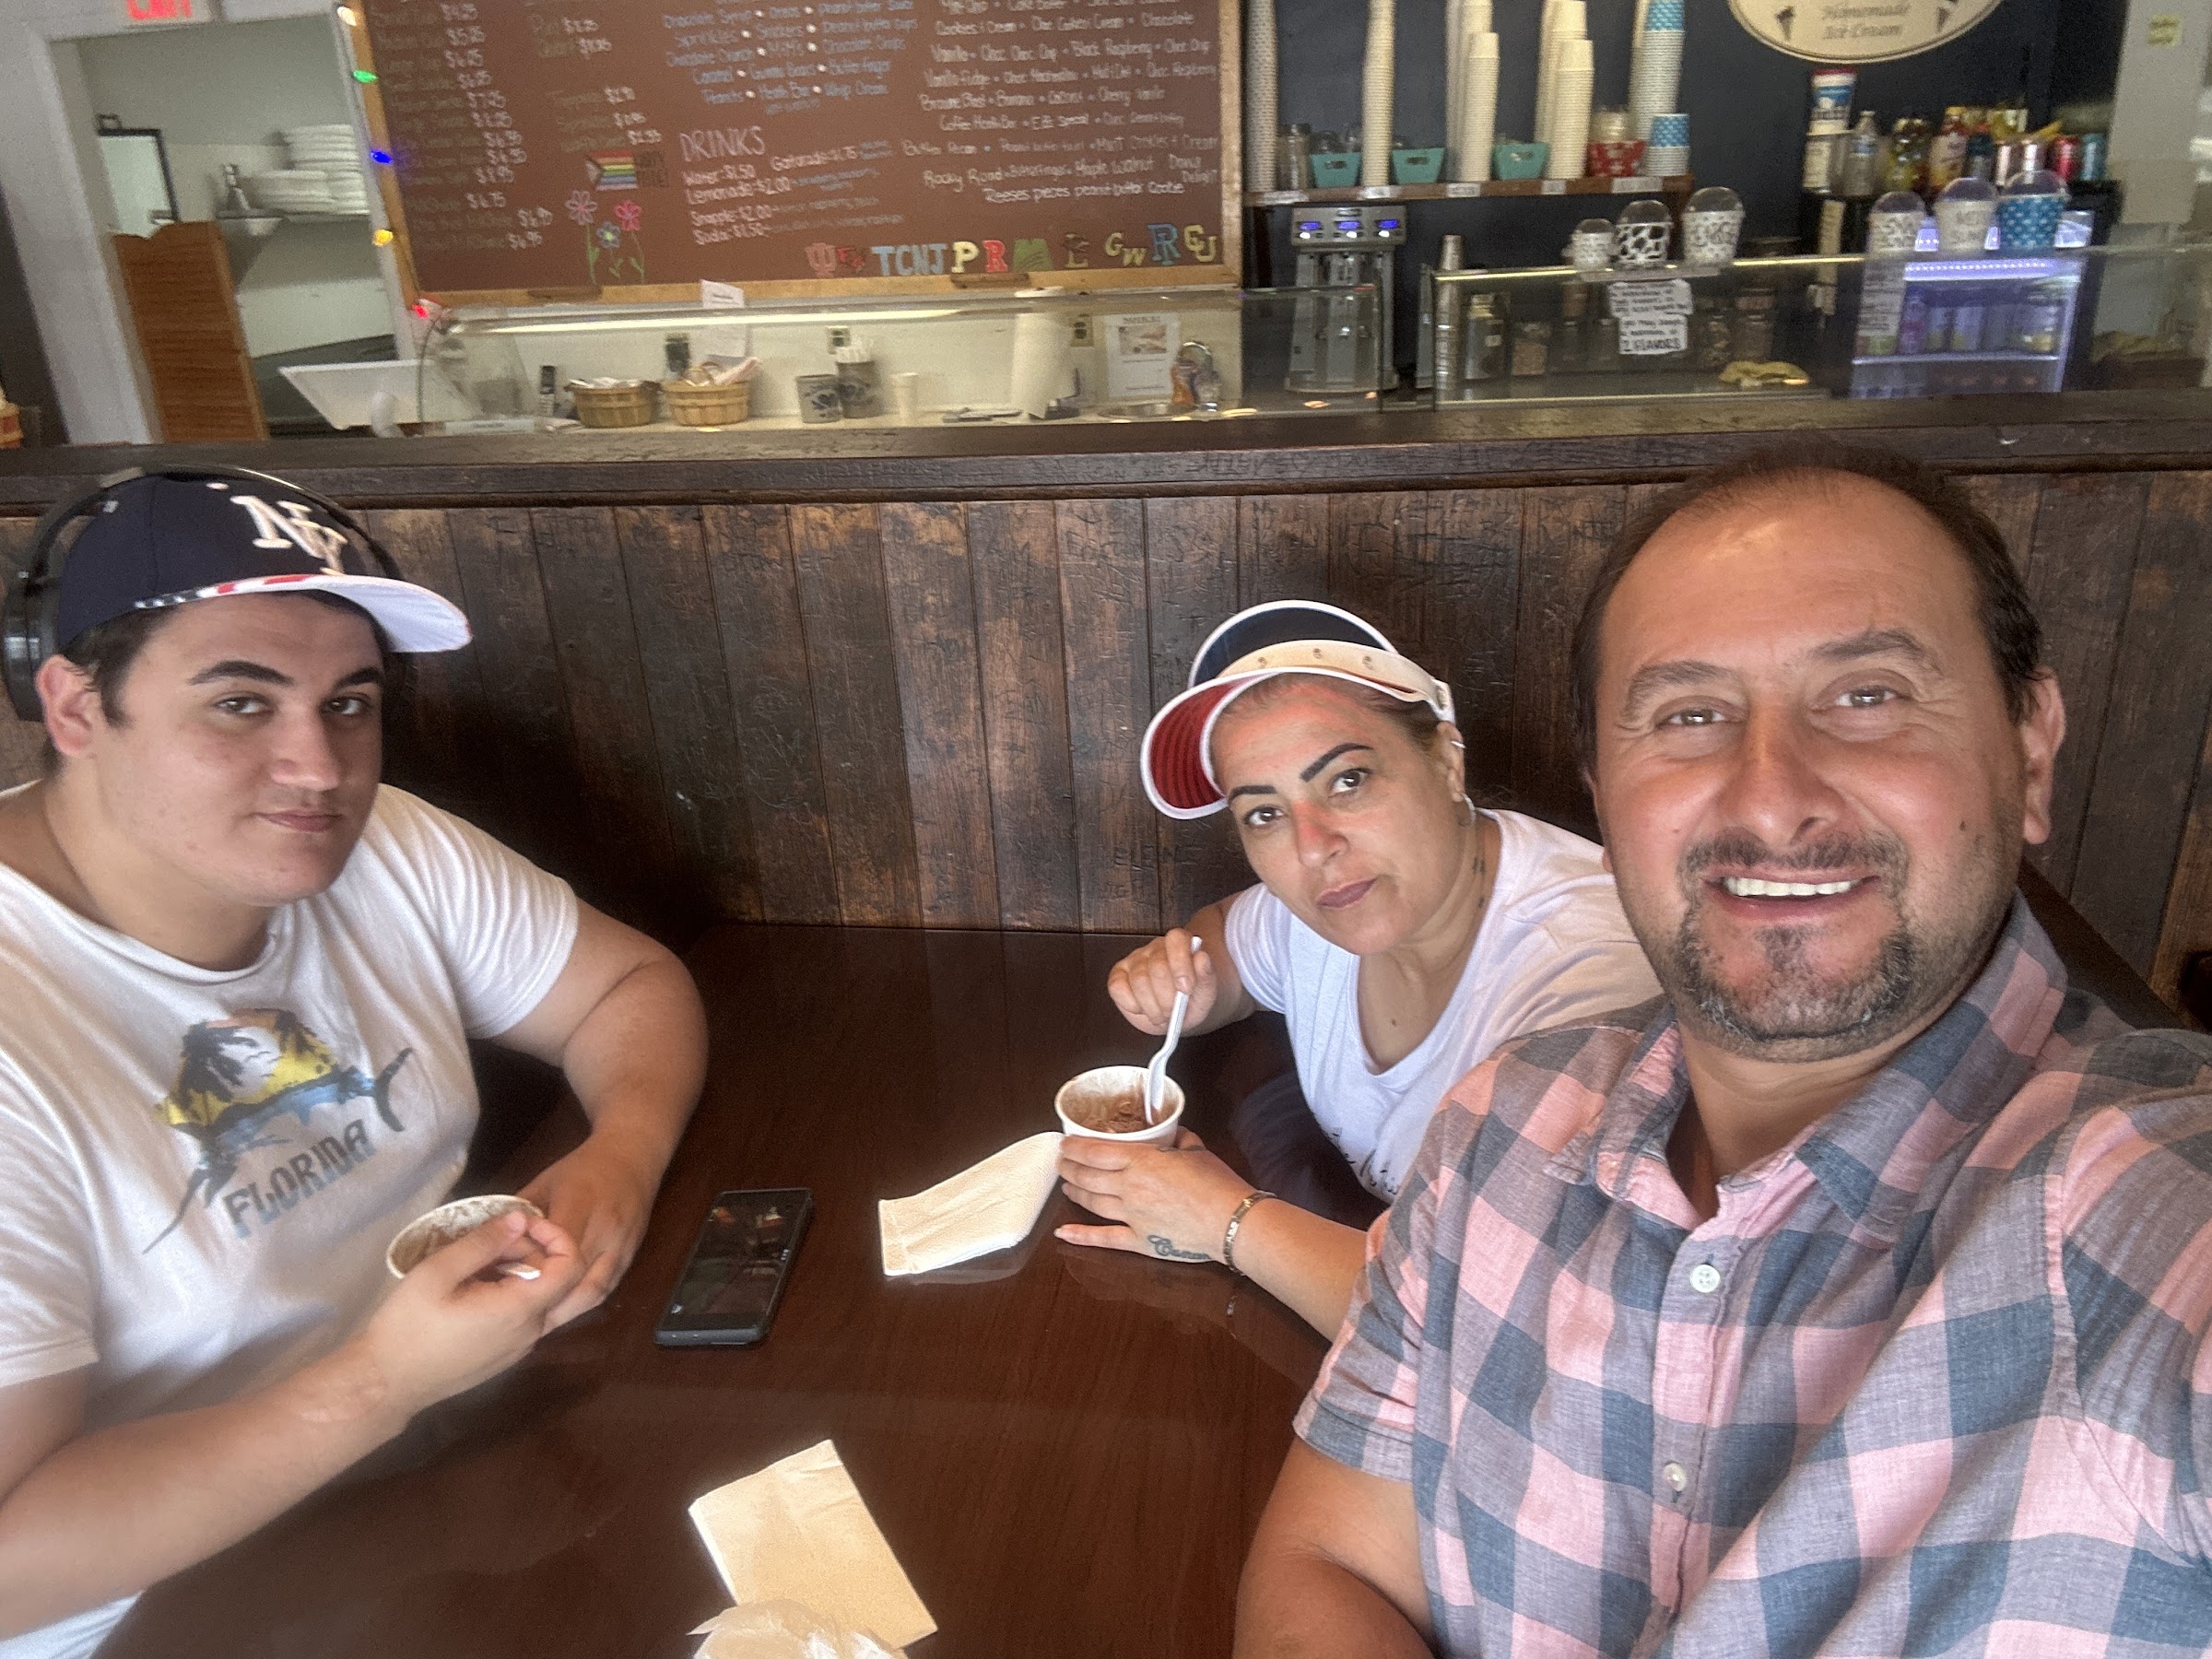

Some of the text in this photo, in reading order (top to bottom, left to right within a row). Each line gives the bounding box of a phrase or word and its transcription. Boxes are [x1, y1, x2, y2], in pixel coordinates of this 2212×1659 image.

[1821, 4, 1912, 20] Homemade
[1851, 23, 1902, 38] Cream
[679, 125, 766, 162] DRINKS
[967, 167, 1004, 186] Road
[871, 243, 948, 276] TCNJ
[951, 241, 979, 274] P
[982, 240, 1008, 272] R
[230, 495, 348, 576] NY
[223, 1119, 376, 1239] FLORIDA
